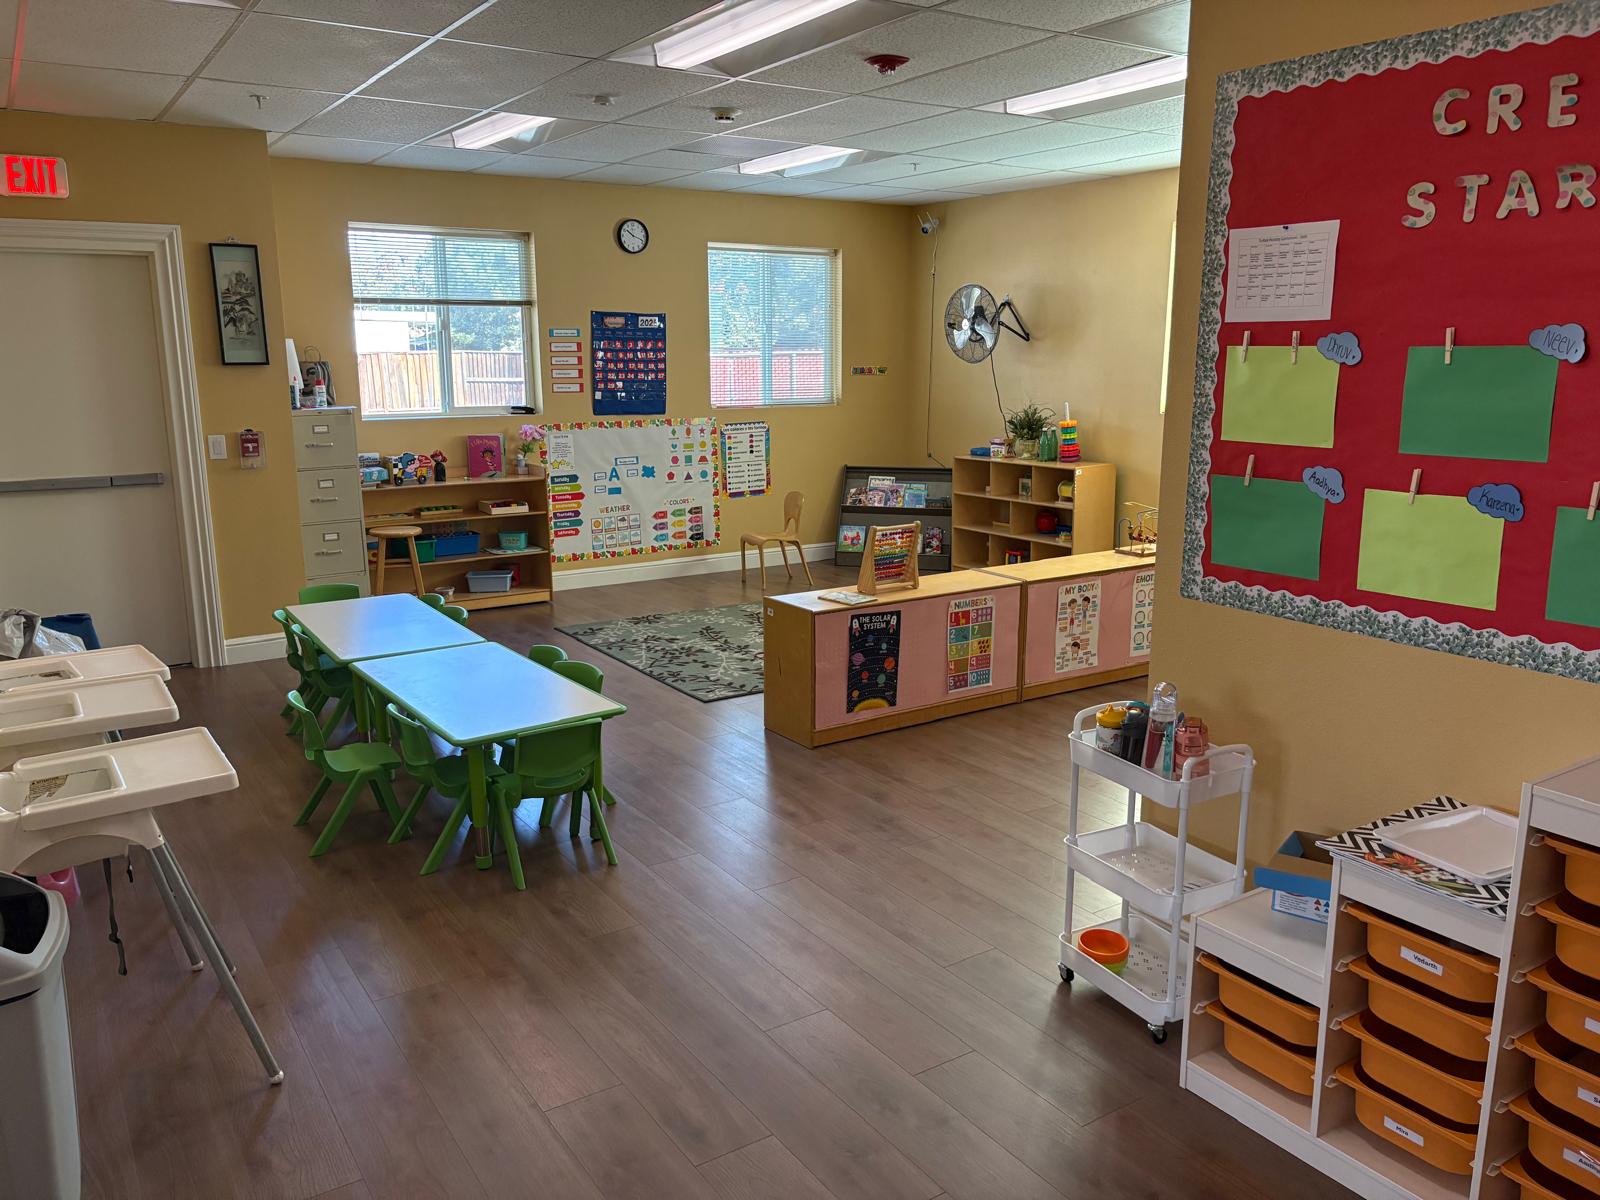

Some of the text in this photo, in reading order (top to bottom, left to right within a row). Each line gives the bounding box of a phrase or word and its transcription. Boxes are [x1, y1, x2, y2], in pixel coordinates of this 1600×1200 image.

[1433, 73, 1579, 136] CRE
[5, 156, 58, 195] EXIT
[1401, 164, 1597, 228] STAR
[608, 467, 620, 482] A
[670, 498, 690, 506] COLORS
[600, 504, 631, 514] WEATHER
[1065, 582, 1096, 596] MY BODY
[954, 597, 988, 610] NUMBERS
[860, 614, 892, 624] THE SOLAR
[863, 622, 887, 630] SYSTEM
[973, 626, 979, 635] 7
[950, 630, 956, 639] 2
[1413, 953, 1438, 970] Vedarth
[1395, 1125, 1409, 1136] Mira
